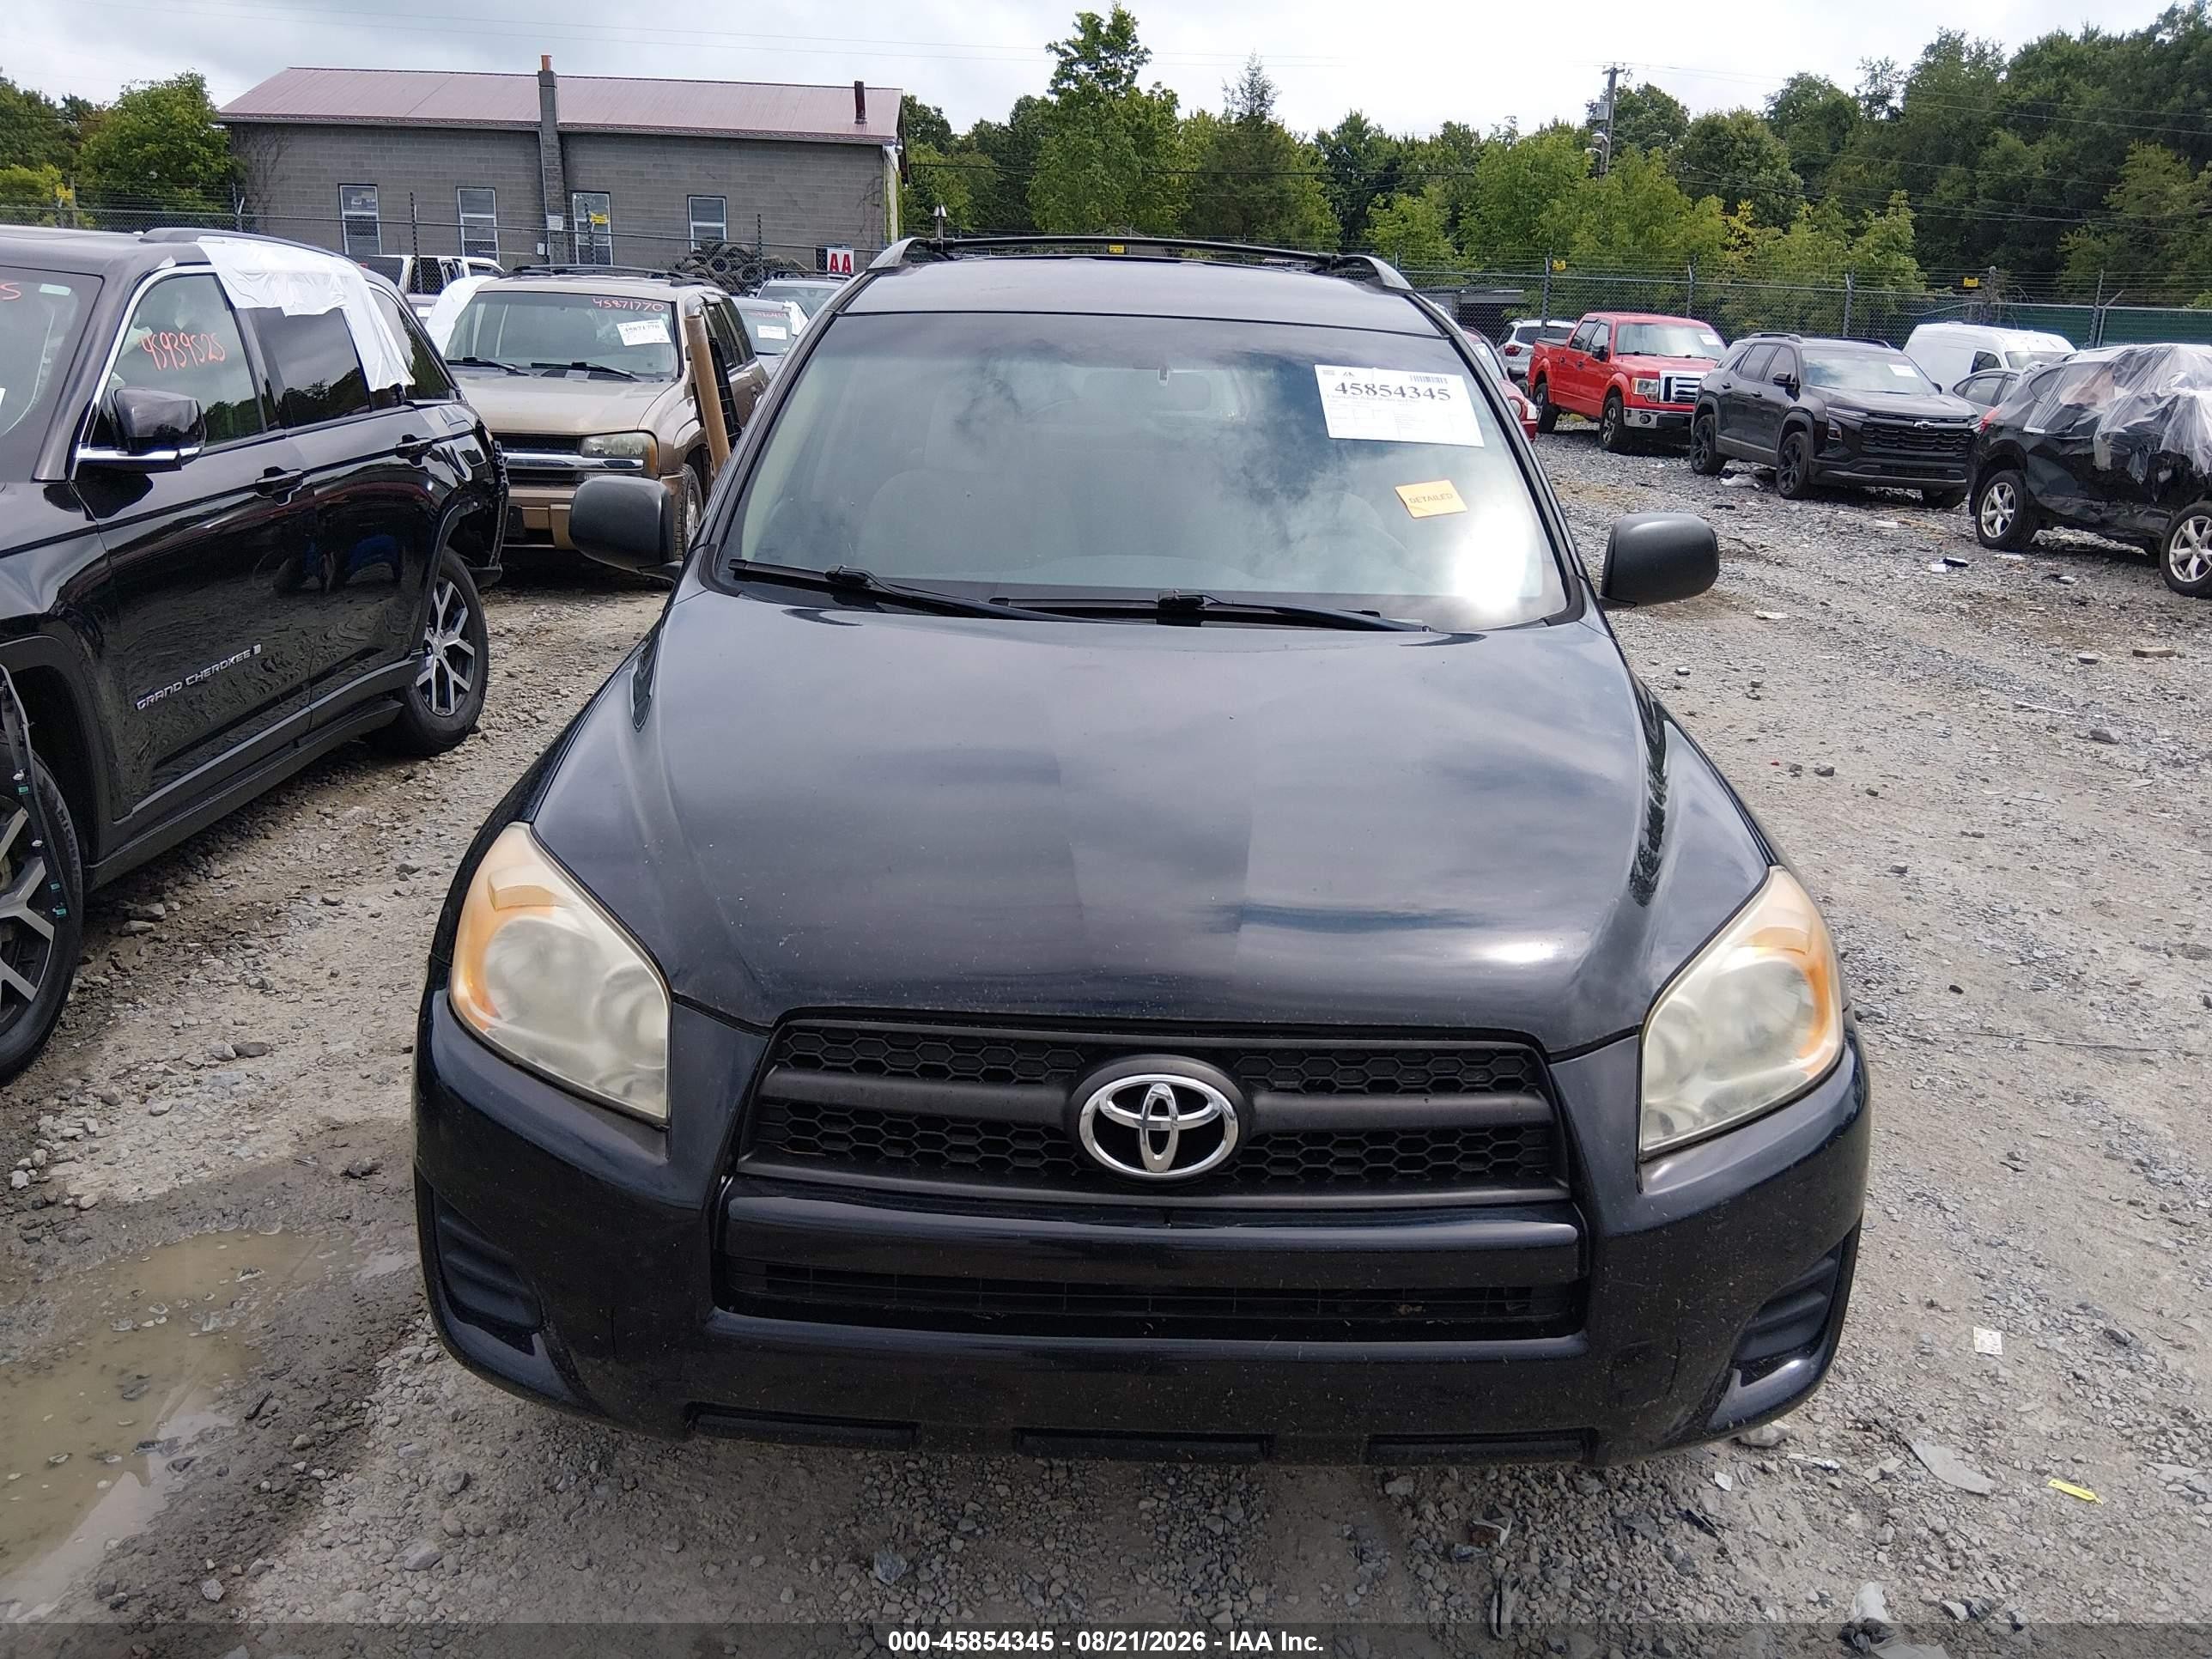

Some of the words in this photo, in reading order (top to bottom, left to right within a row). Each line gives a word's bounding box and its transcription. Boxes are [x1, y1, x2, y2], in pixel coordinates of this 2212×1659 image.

[829, 252, 852, 274] AA
[592, 298, 665, 312] 45871770
[141, 331, 226, 371] 45939525
[1334, 382, 1451, 401] 45854345
[1408, 493, 1454, 504] DETAILED
[136, 681, 183, 711] GRAND
[185, 649, 251, 686] CHEROKEE
